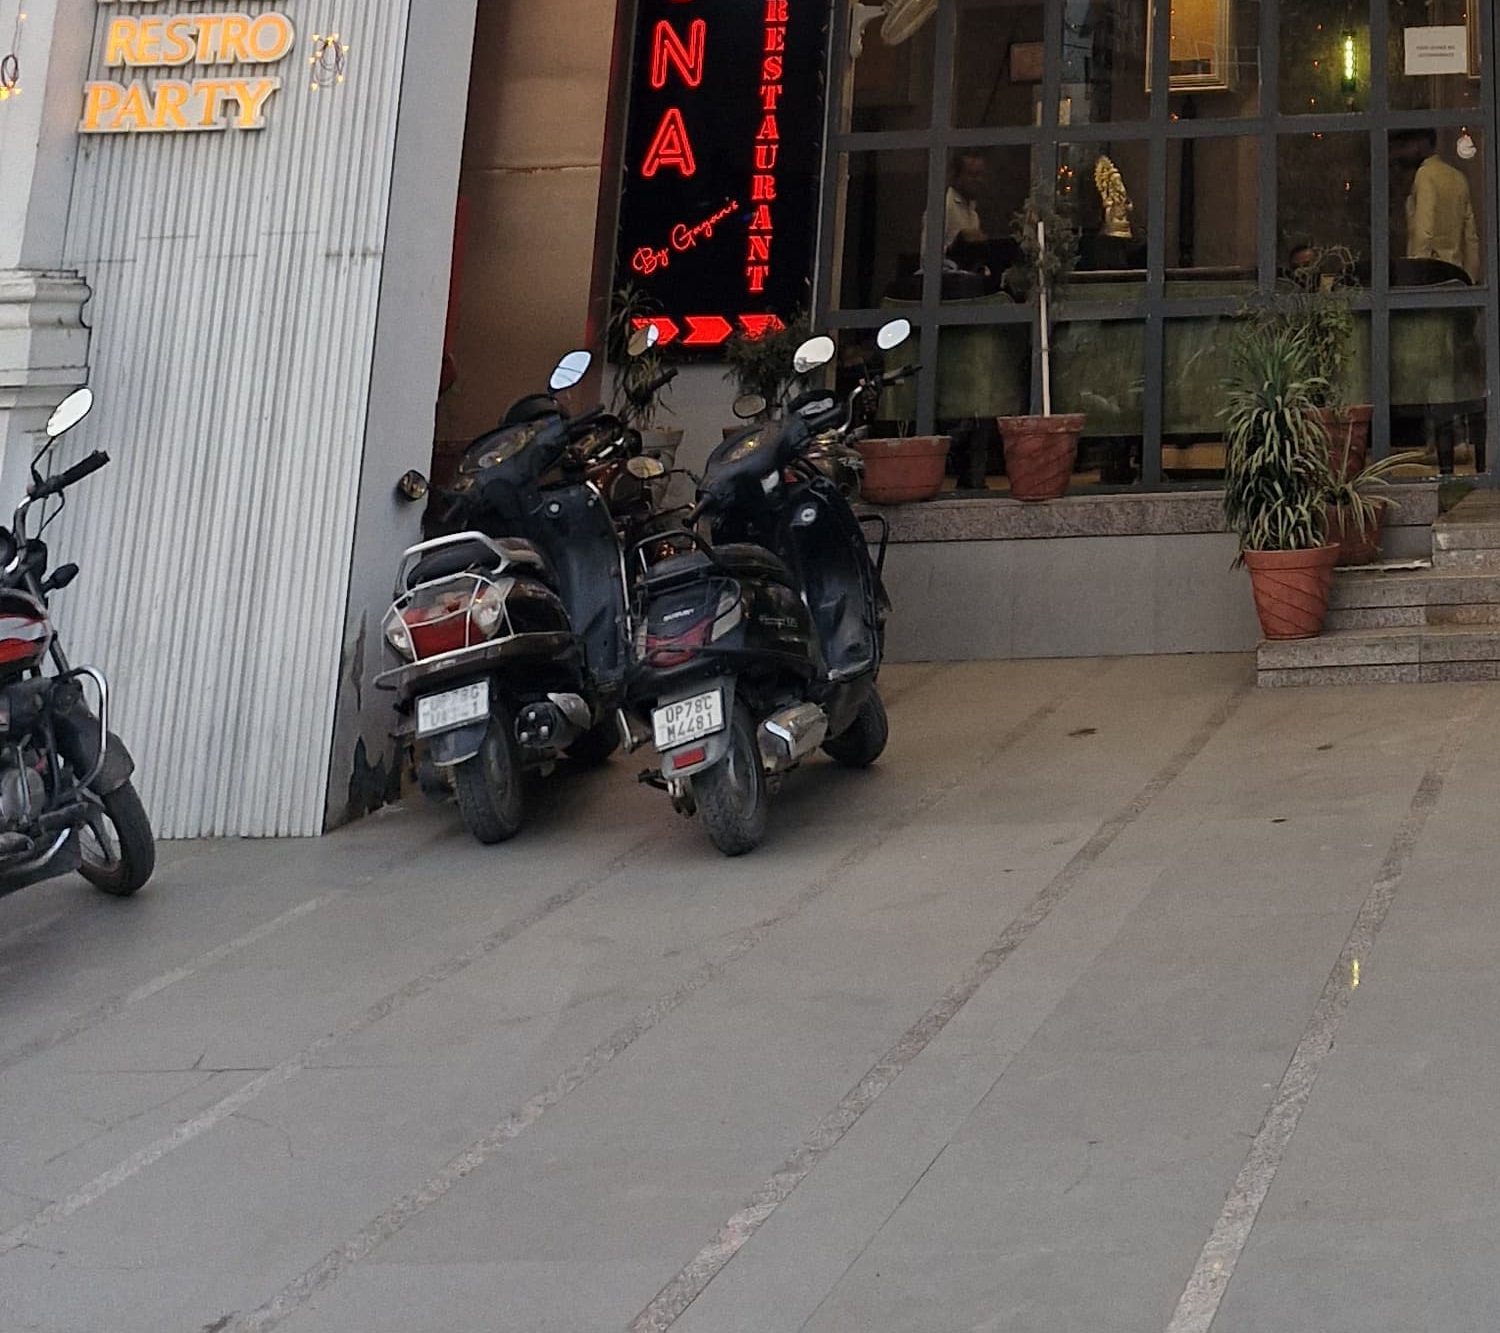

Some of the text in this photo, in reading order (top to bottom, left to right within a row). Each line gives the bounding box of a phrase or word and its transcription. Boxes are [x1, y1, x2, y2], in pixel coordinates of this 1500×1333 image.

[104, 13, 295, 70] RESTRO
[78, 75, 282, 133] PARTY
[632, 247, 670, 275] By
[665, 695, 714, 726] UP78C
